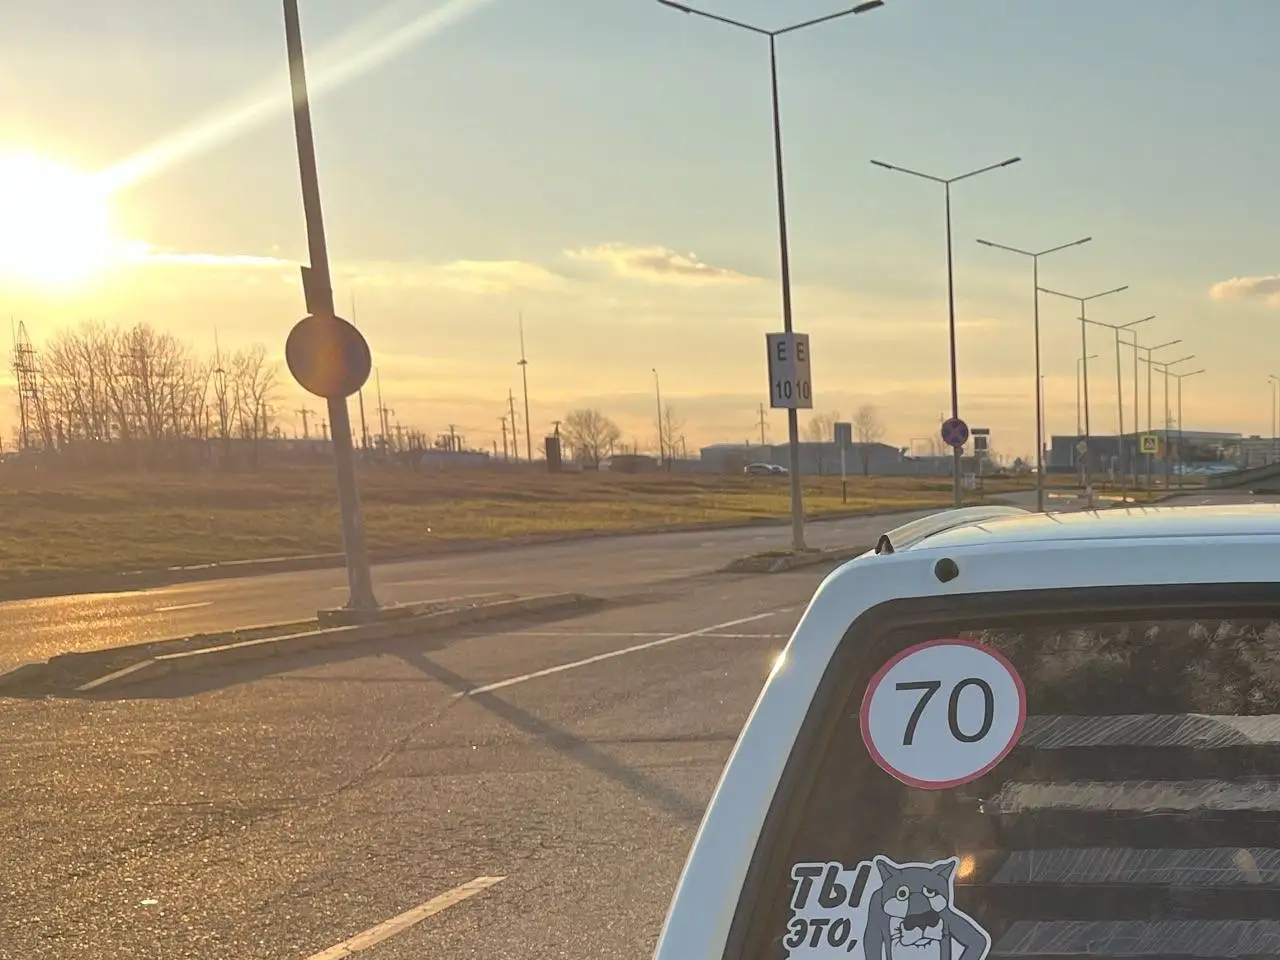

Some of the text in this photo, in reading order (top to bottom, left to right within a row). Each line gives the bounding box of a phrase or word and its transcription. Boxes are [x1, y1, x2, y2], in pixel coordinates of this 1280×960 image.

[775, 380, 792, 400] 10
[796, 380, 810, 400] 10
[895, 677, 995, 746] 70
[794, 865, 872, 910] ТЫ
[786, 918, 858, 953] ЭТО,
